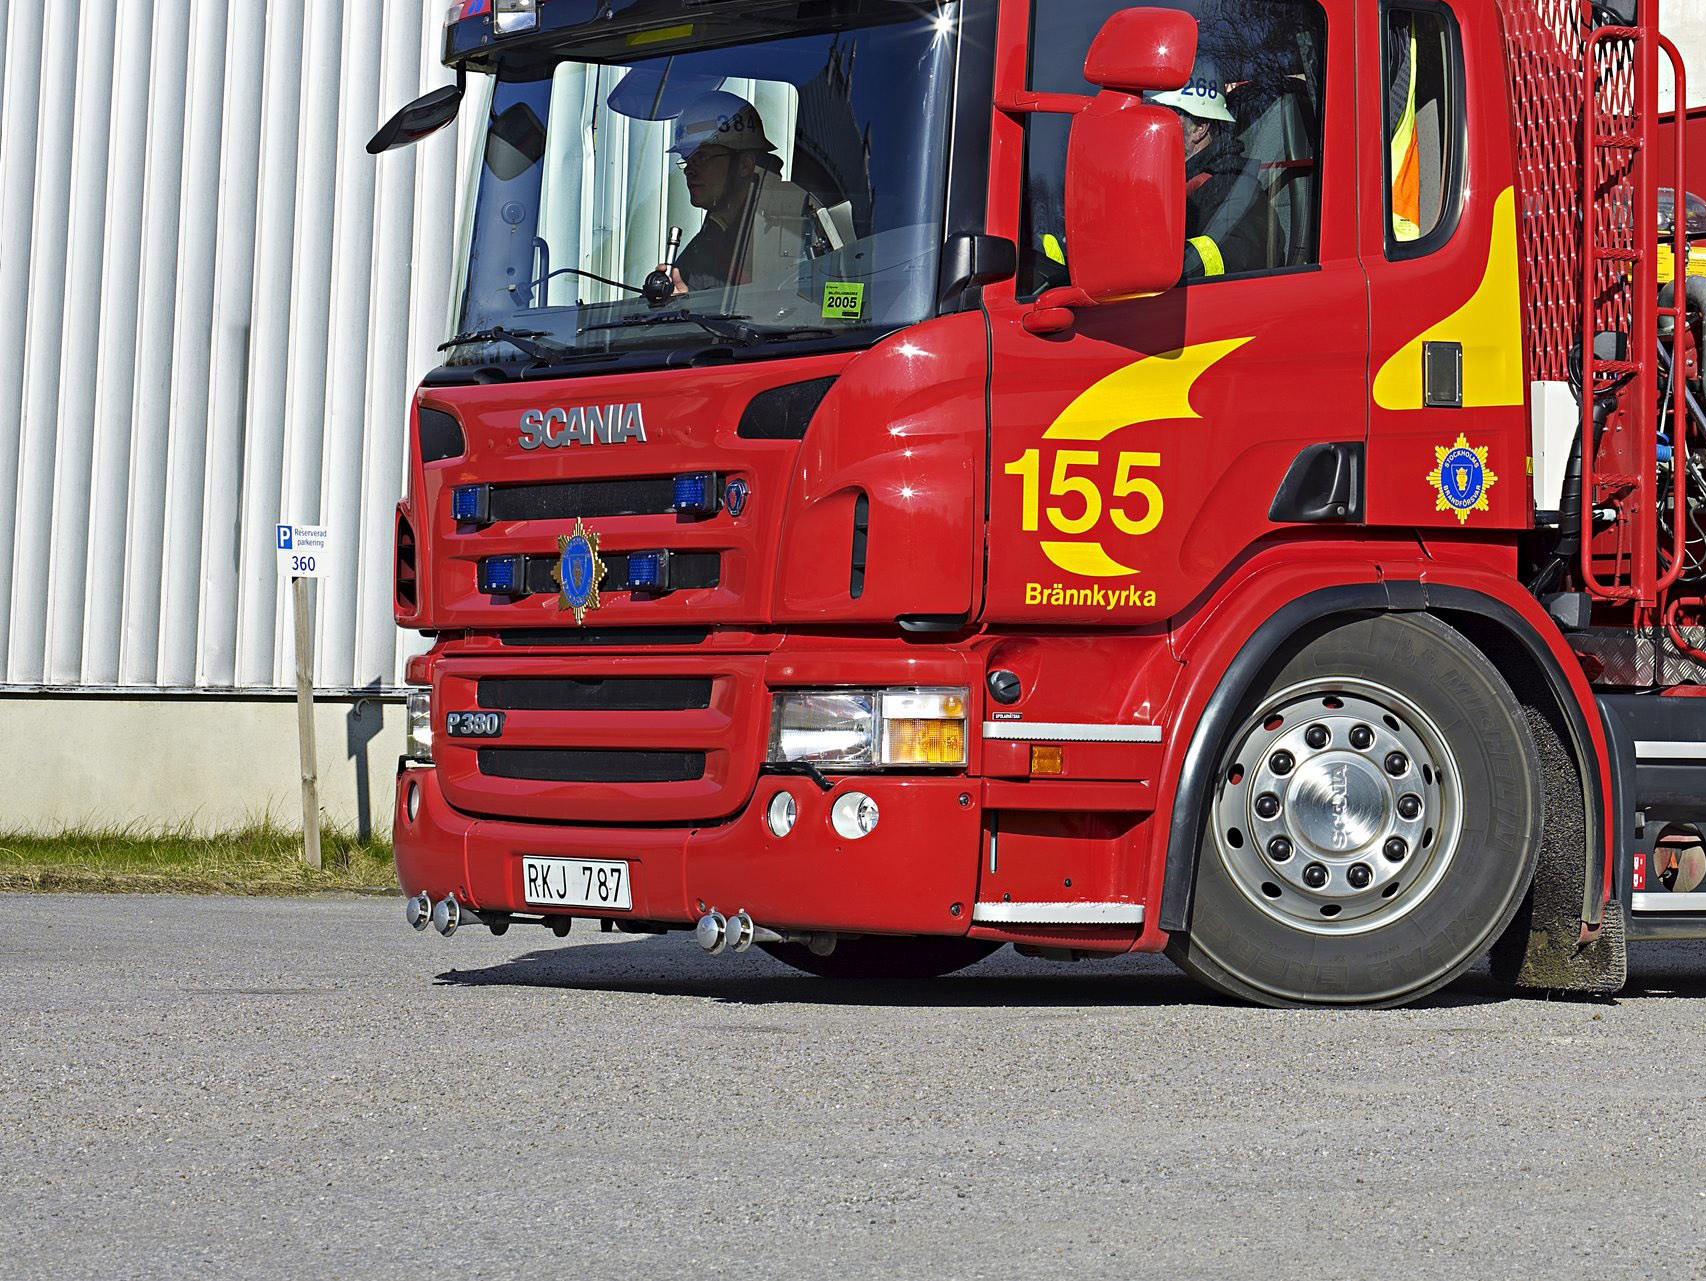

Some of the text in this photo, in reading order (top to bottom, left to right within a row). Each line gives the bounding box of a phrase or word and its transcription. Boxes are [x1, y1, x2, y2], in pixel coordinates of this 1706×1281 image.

[1181, 78, 1218, 99] 268
[827, 296, 857, 308] 2005
[518, 403, 647, 450] SCANIA
[1444, 450, 1480, 468] STOCKHOLMS
[1004, 449, 1164, 536] 155
[1443, 485, 1481, 507] BRANDFÖRSVAR
[294, 528, 327, 537] Reserverad
[297, 539, 325, 548] parkering
[291, 555, 316, 571] 360
[1025, 582, 1156, 610] Brännkyrka
[448, 713, 499, 734] P 380
[528, 864, 622, 902] RKJ 787
